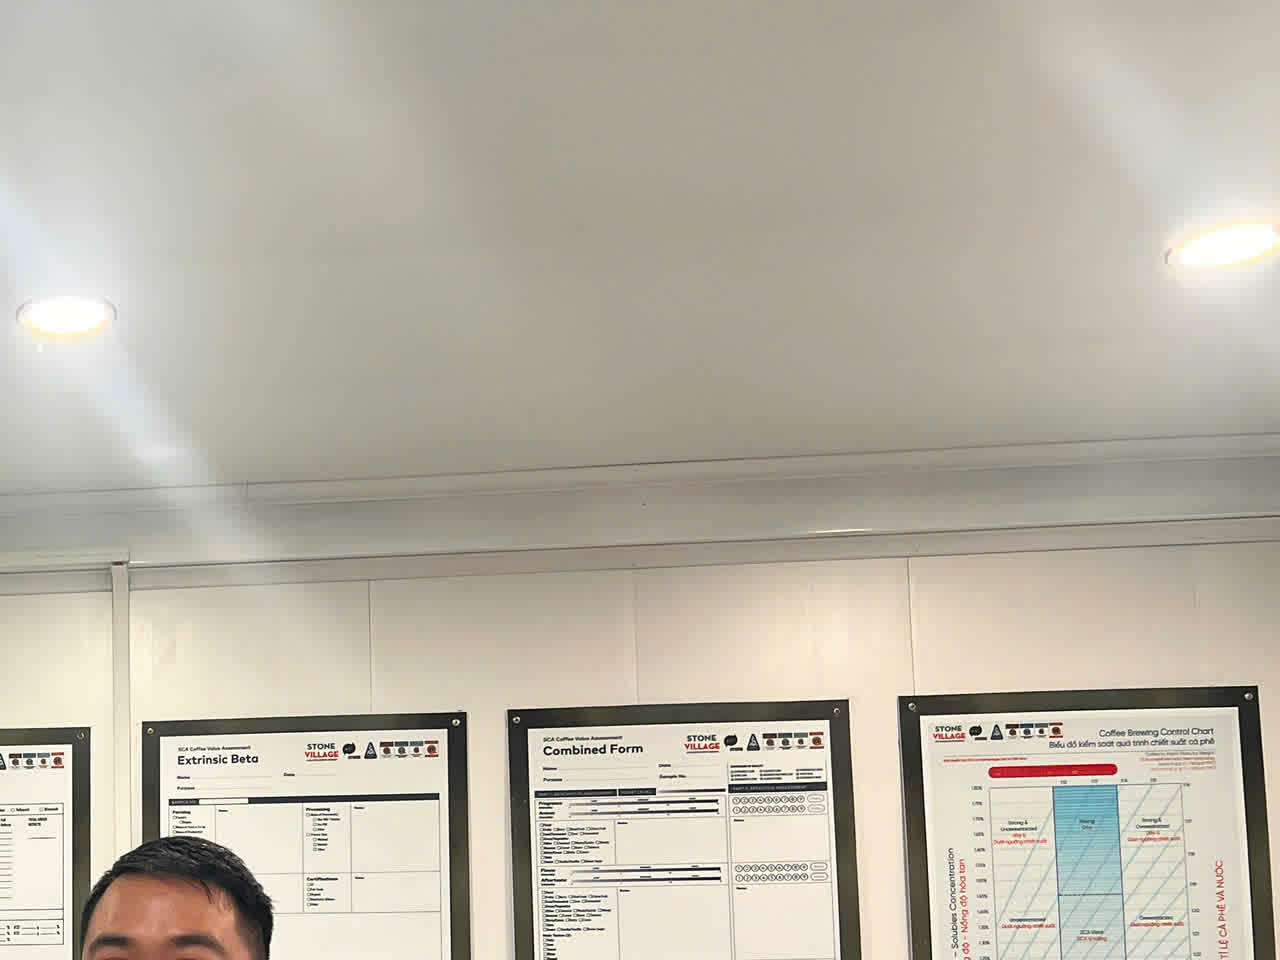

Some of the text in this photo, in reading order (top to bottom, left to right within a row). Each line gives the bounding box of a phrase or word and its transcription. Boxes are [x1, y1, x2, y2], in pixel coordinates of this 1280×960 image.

[687, 734, 717, 742] STONE
[1099, 729, 1126, 738] Coffee
[1160, 727, 1189, 736] Control
[1191, 727, 1214, 736] Chart
[307, 743, 336, 751] STONE
[543, 744, 643, 756] Combined Form
[684, 742, 720, 750] VILLAGE
[177, 754, 259, 765] Extrinsic Beta
[305, 751, 339, 759] VILLAGE
[958, 859, 966, 874] tan
[947, 847, 957, 912] Concentration
[951, 913, 959, 950] Solubles
